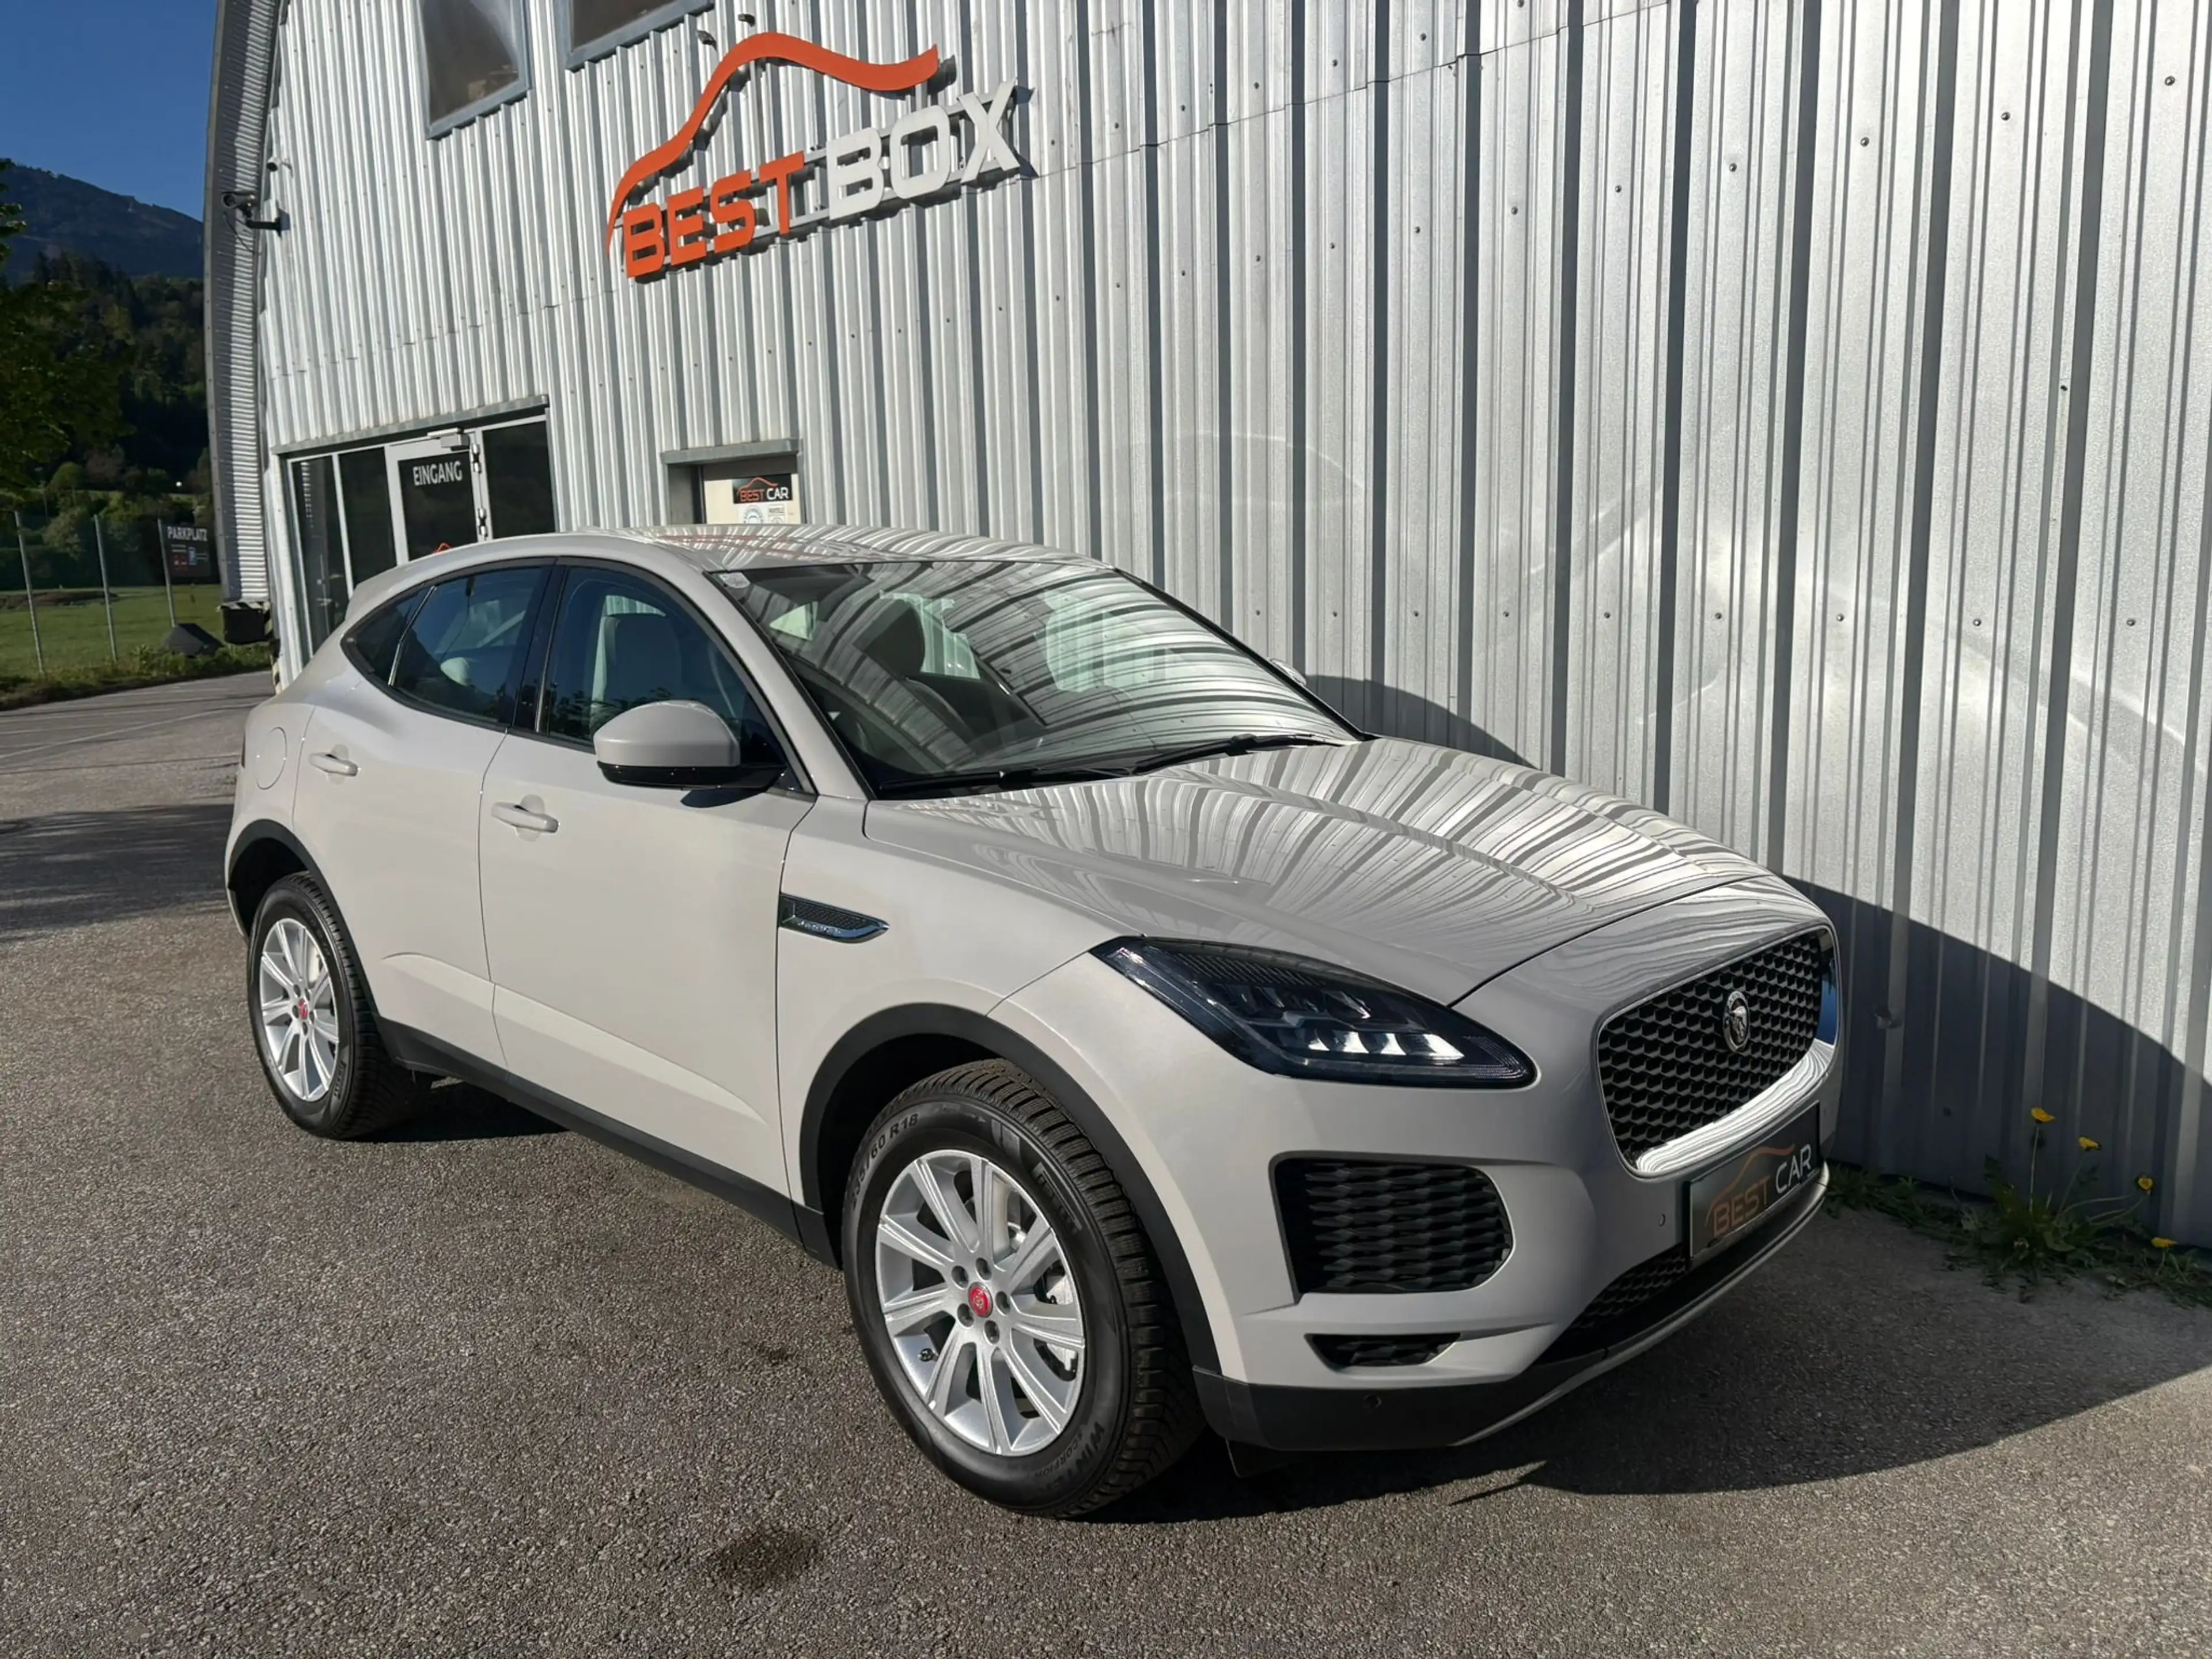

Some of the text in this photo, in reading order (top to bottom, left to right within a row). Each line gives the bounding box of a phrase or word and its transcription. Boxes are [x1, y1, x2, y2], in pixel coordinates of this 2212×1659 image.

[623, 77, 1021, 279] BEST BOX
[412, 461, 463, 486] EINGANG
[739, 487, 789, 502] BEST CAR
[167, 526, 208, 541] PARKPLATZ
[889, 1113, 919, 1139] R18
[1713, 1143, 1812, 1238] BEST CAR
